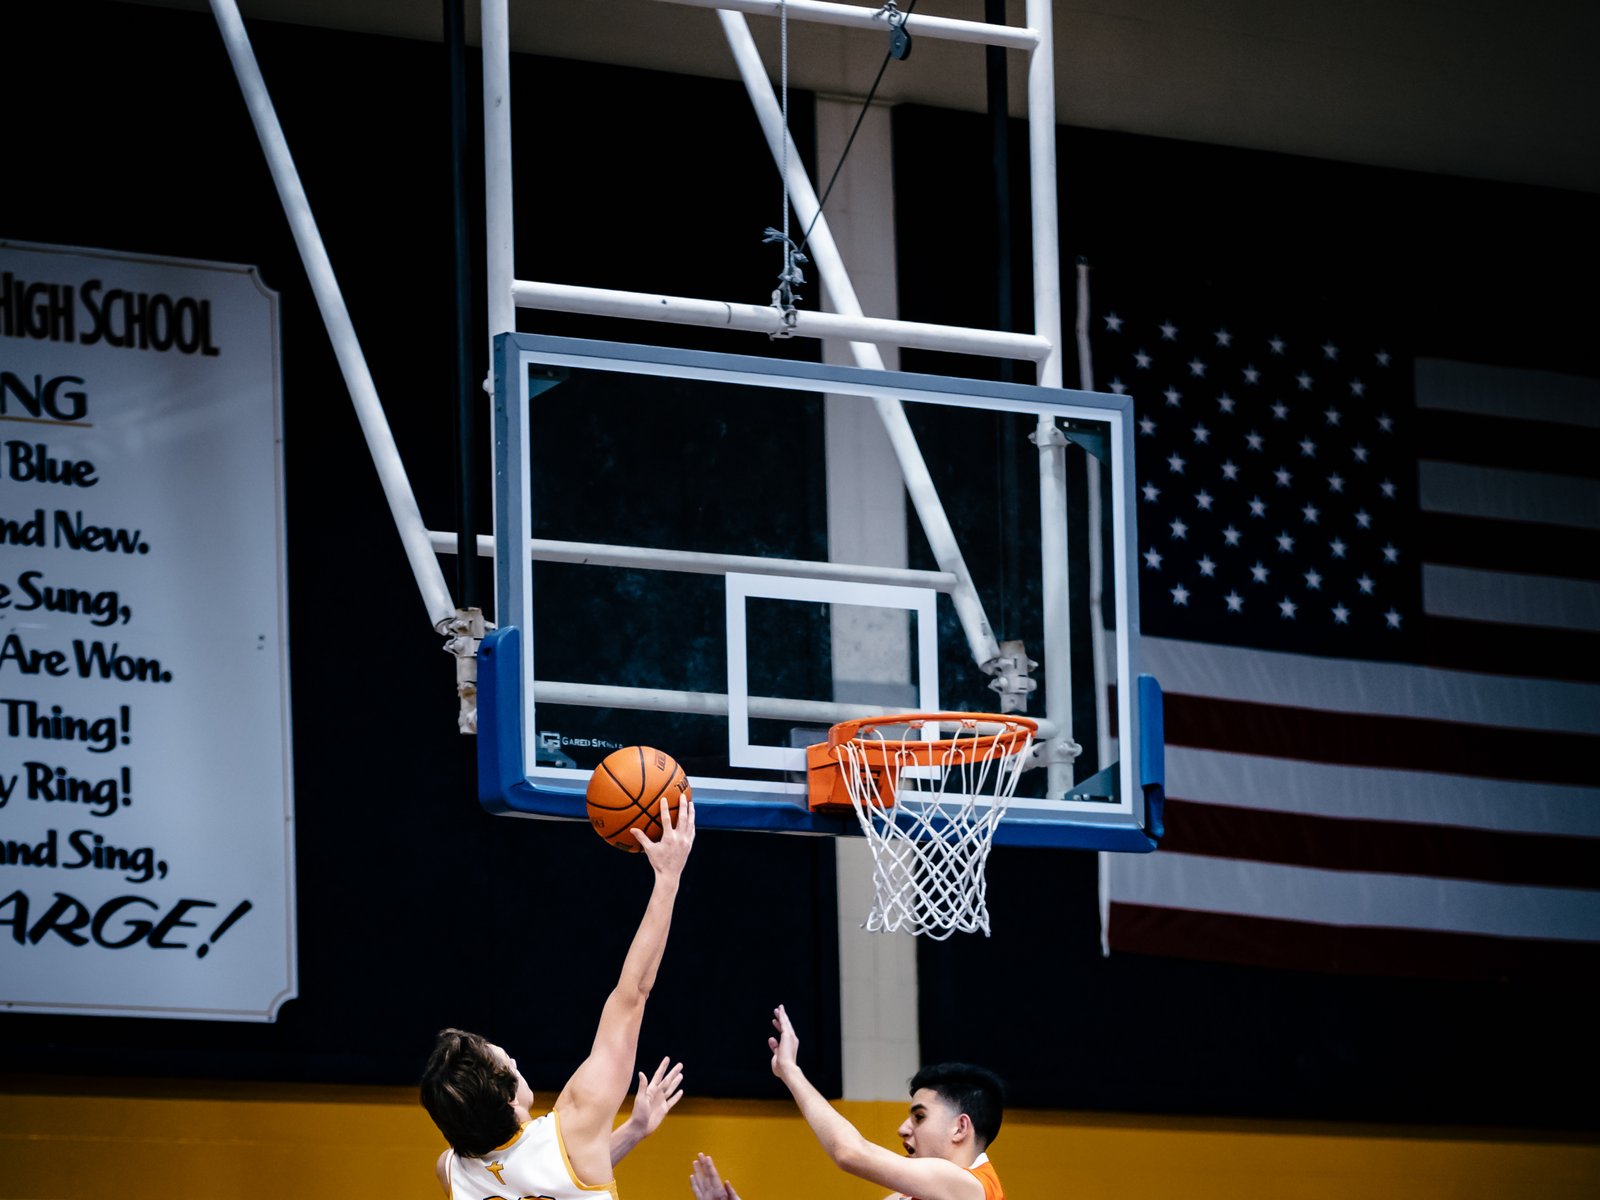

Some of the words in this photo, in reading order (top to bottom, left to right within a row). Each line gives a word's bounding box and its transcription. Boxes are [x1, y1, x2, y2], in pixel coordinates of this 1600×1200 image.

[79, 278, 221, 357] SCHOOL
[0, 370, 89, 421] NG
[3, 440, 100, 488] Blue
[53, 509, 150, 555] New.
[14, 571, 132, 628] Sung,
[0, 633, 70, 677] Are
[72, 639, 173, 684] Won.
[0, 699, 131, 753] Thing!
[22, 760, 132, 817] Ring!
[62, 829, 169, 884] Sing,
[0, 890, 253, 960] ARGE!
